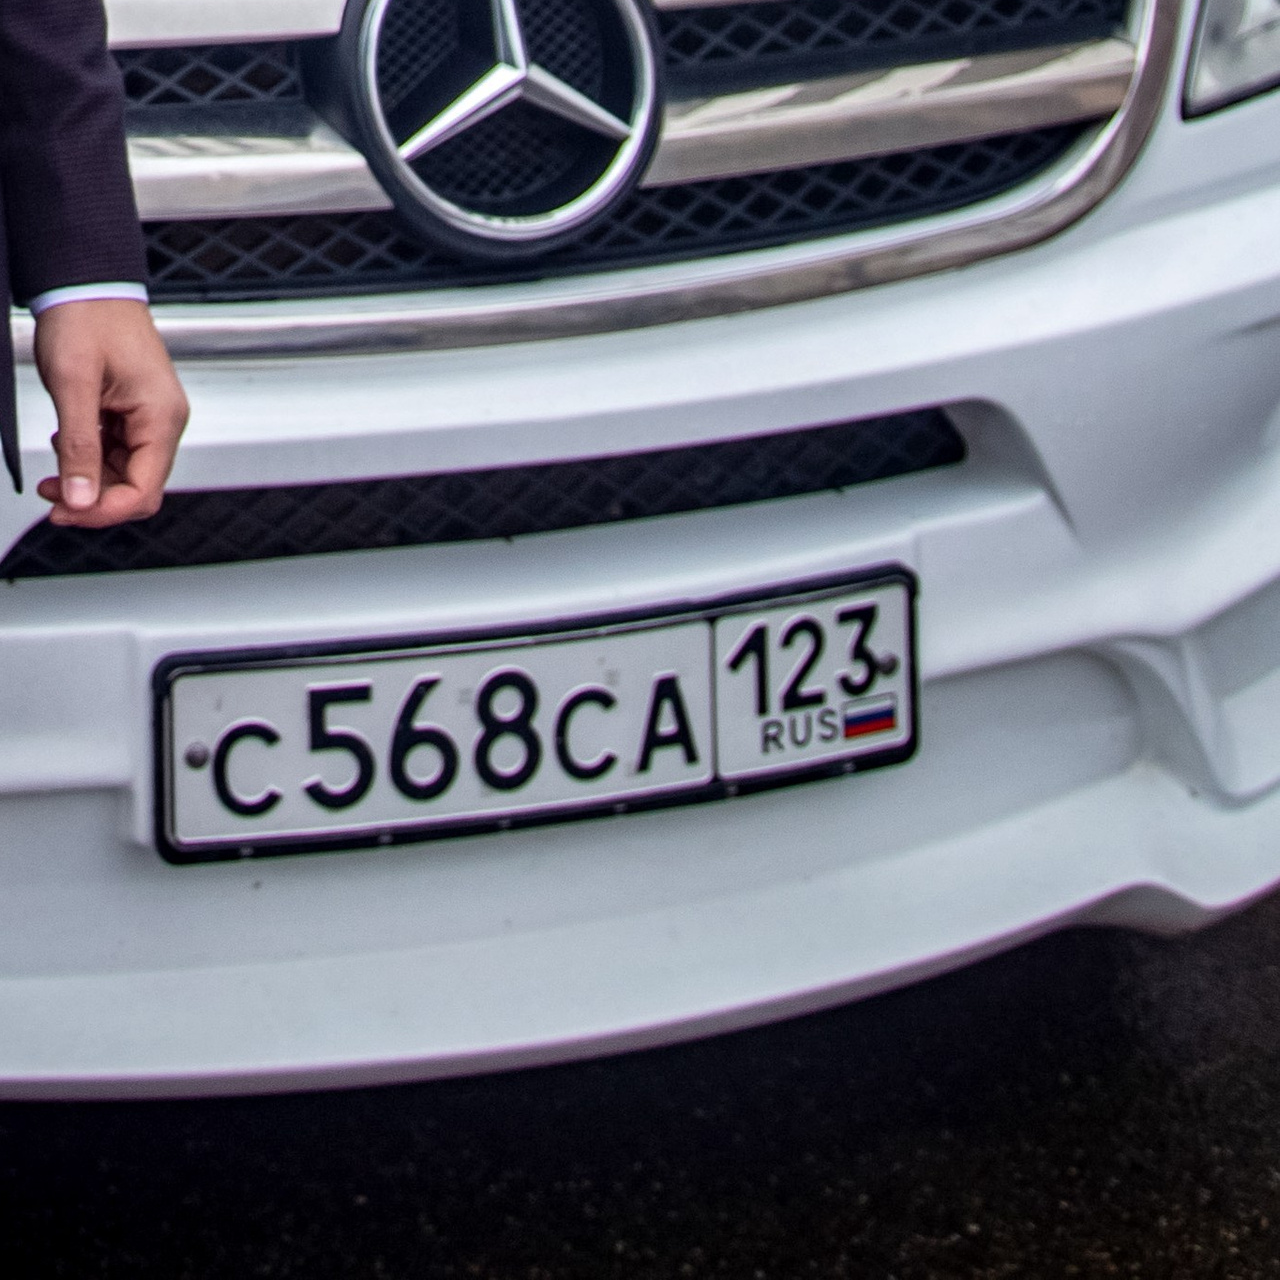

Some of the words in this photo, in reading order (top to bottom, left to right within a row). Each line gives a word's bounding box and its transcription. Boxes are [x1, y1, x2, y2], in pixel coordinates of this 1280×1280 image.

[213, 668, 699, 816] C568CA
[728, 604, 880, 712] 123
[761, 709, 839, 755] RUS
